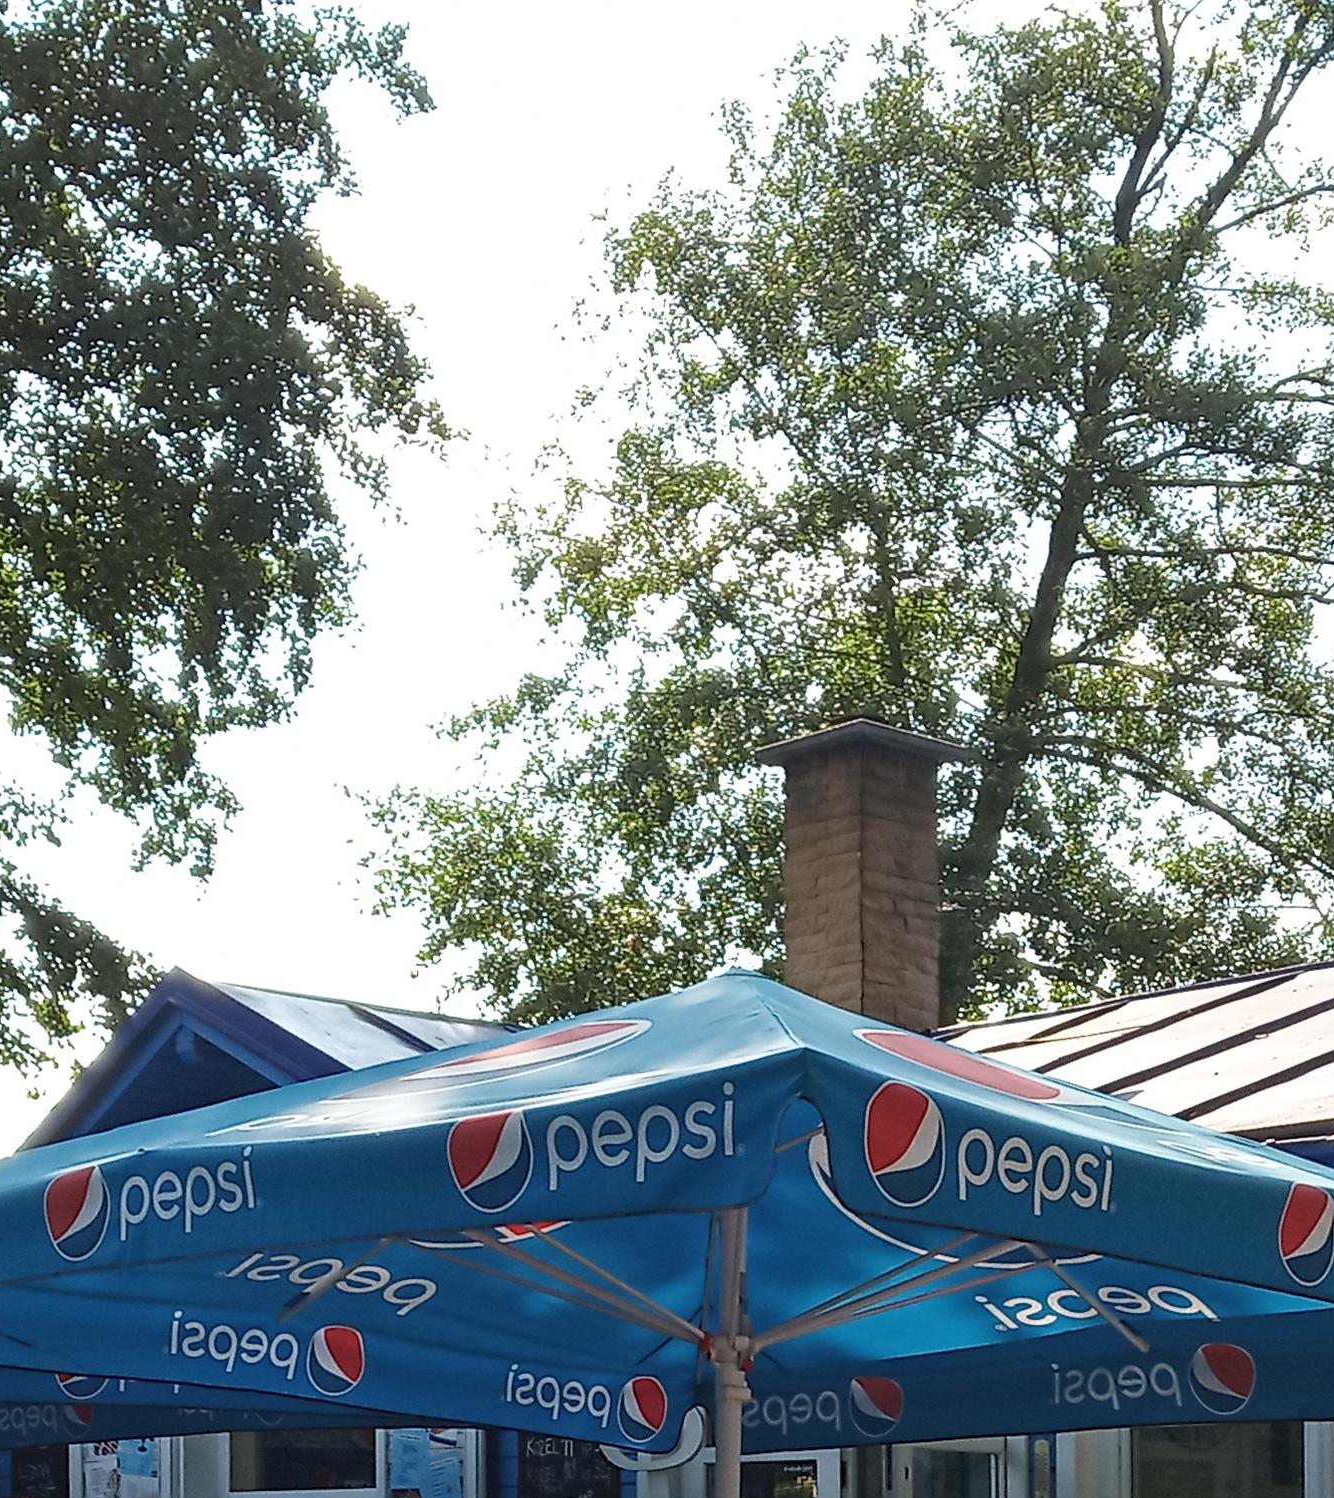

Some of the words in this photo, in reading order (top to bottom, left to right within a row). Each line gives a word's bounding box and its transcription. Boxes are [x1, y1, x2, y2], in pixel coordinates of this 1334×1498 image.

[546, 1082, 737, 1191] pepsi
[957, 1126, 1115, 1217] pepsi
[120, 1147, 257, 1239] pepsi
